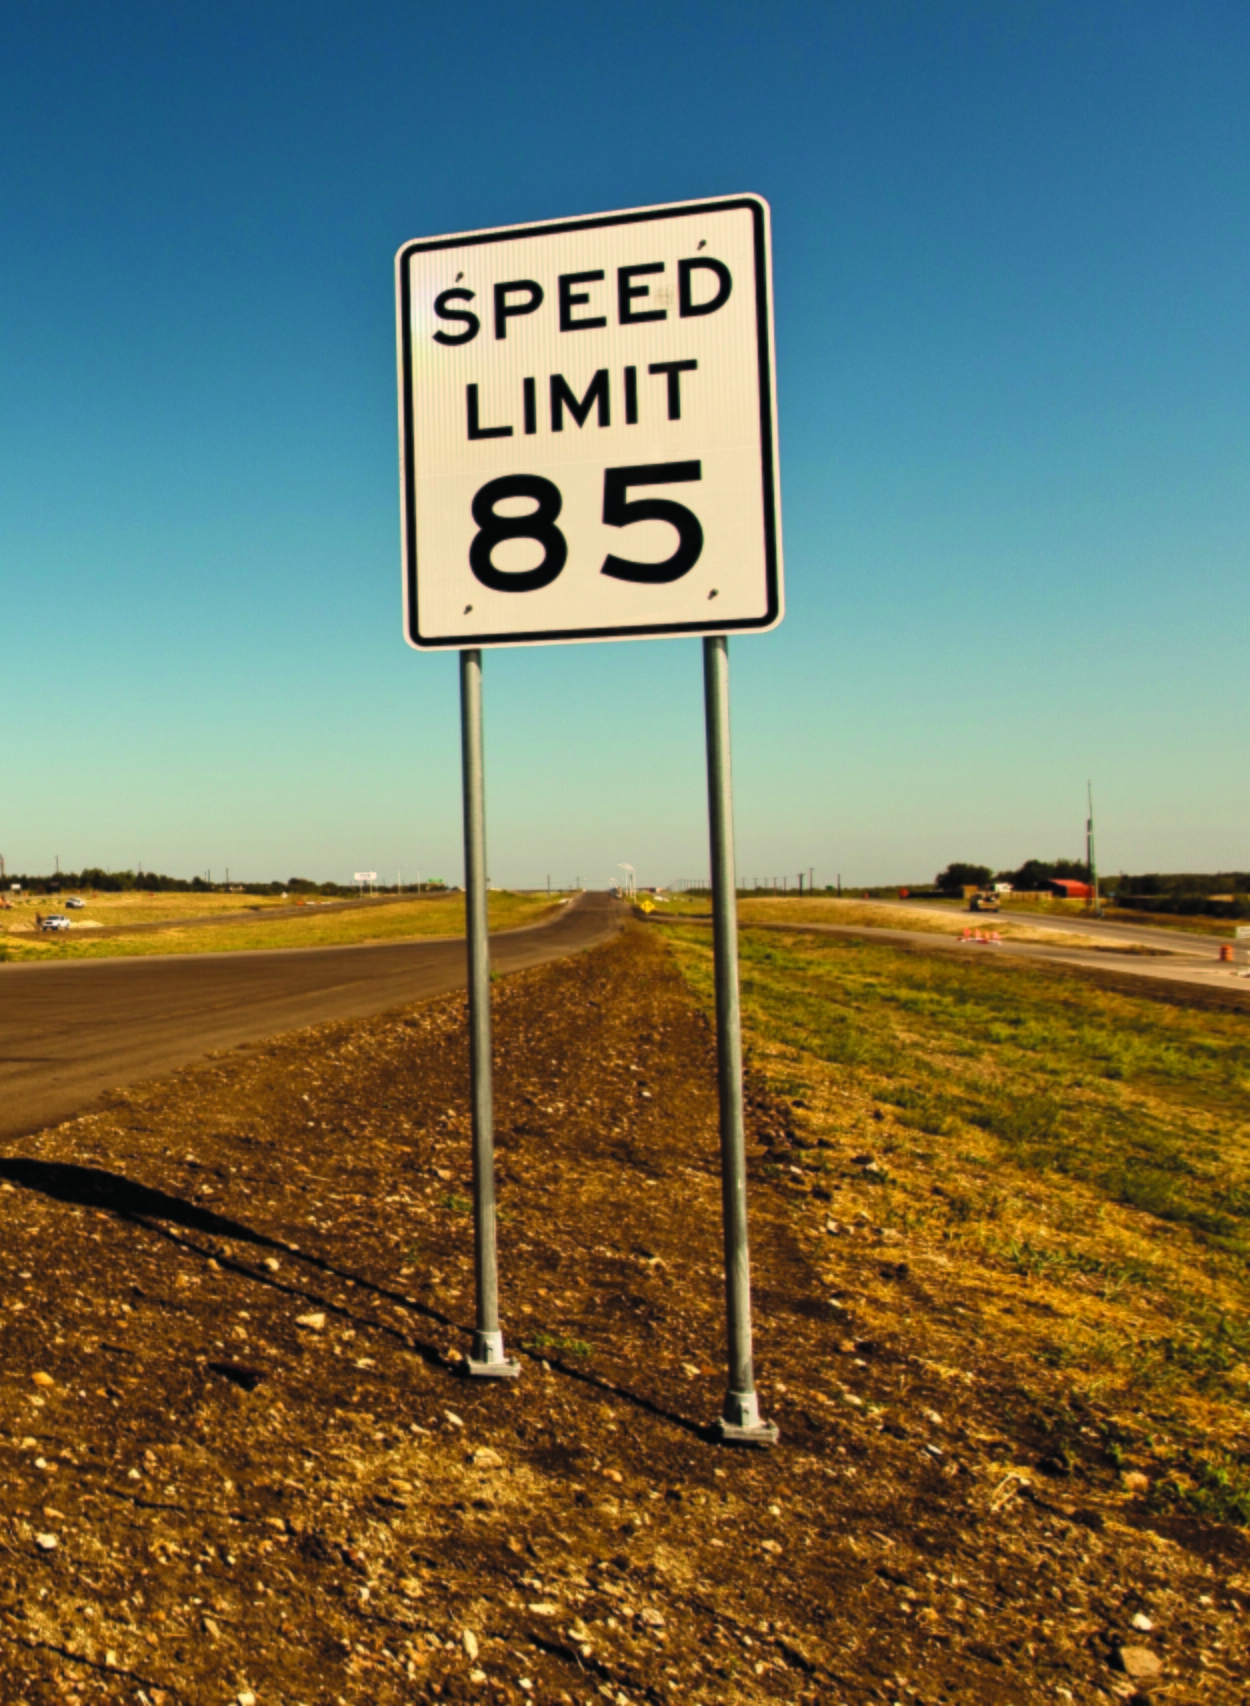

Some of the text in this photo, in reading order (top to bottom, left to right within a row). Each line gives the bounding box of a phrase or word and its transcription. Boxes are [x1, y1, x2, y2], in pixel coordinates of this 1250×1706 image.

[432, 257, 733, 347] SPEED
[466, 359, 698, 441] LIMIT
[468, 459, 704, 593] 85
